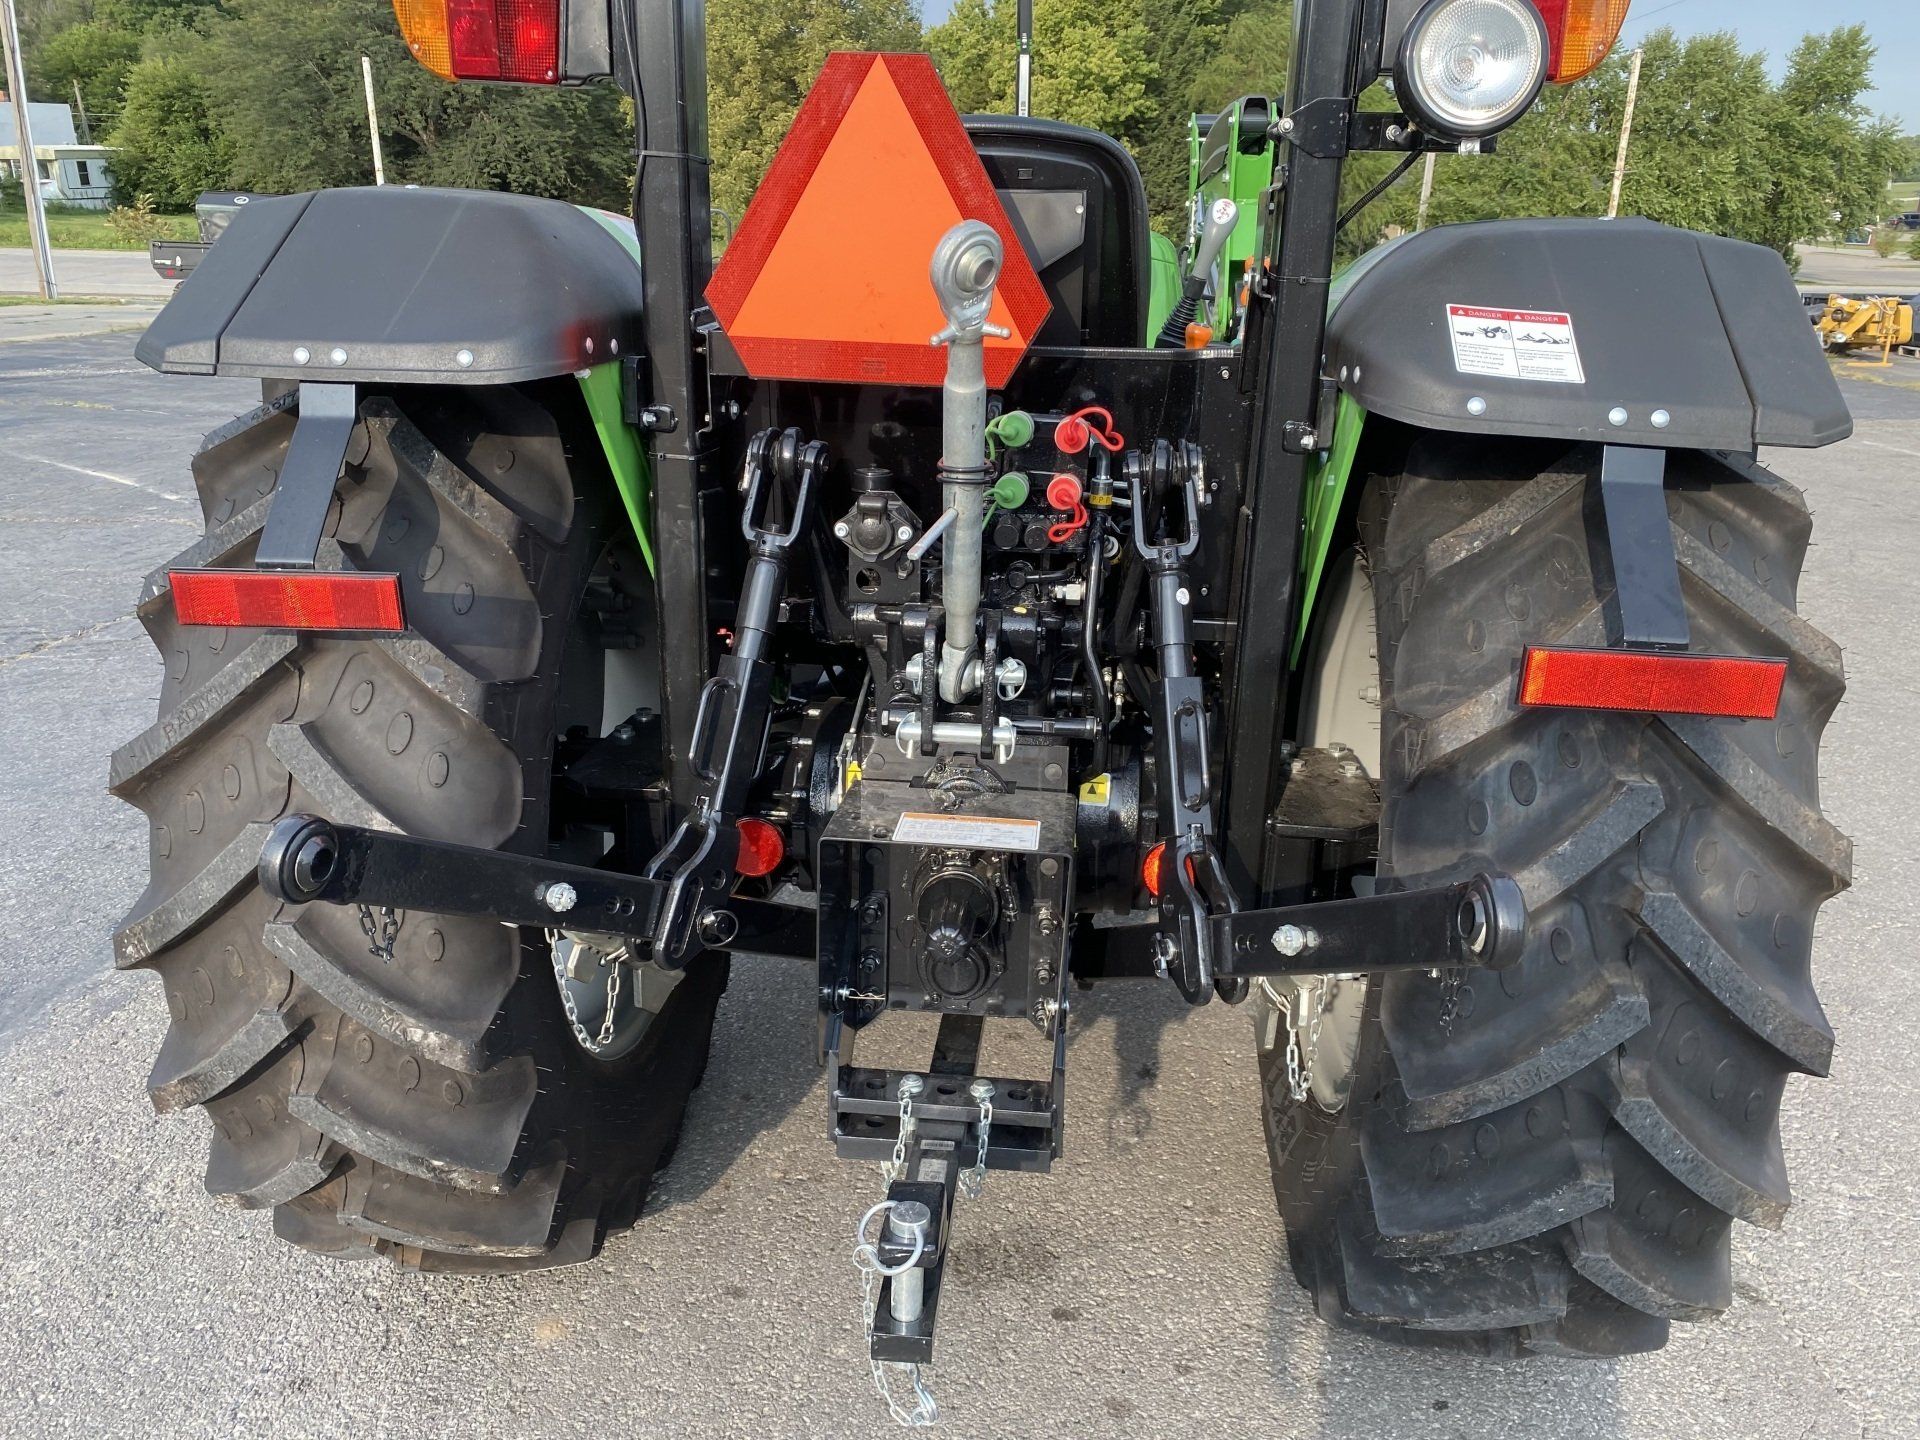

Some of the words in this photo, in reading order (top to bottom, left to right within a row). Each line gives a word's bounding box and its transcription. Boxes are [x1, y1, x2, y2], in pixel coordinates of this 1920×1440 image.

[1468, 311, 1502, 319] DANGER
[1524, 314, 1559, 322] DANGER
[163, 685, 229, 741] RADIAL
